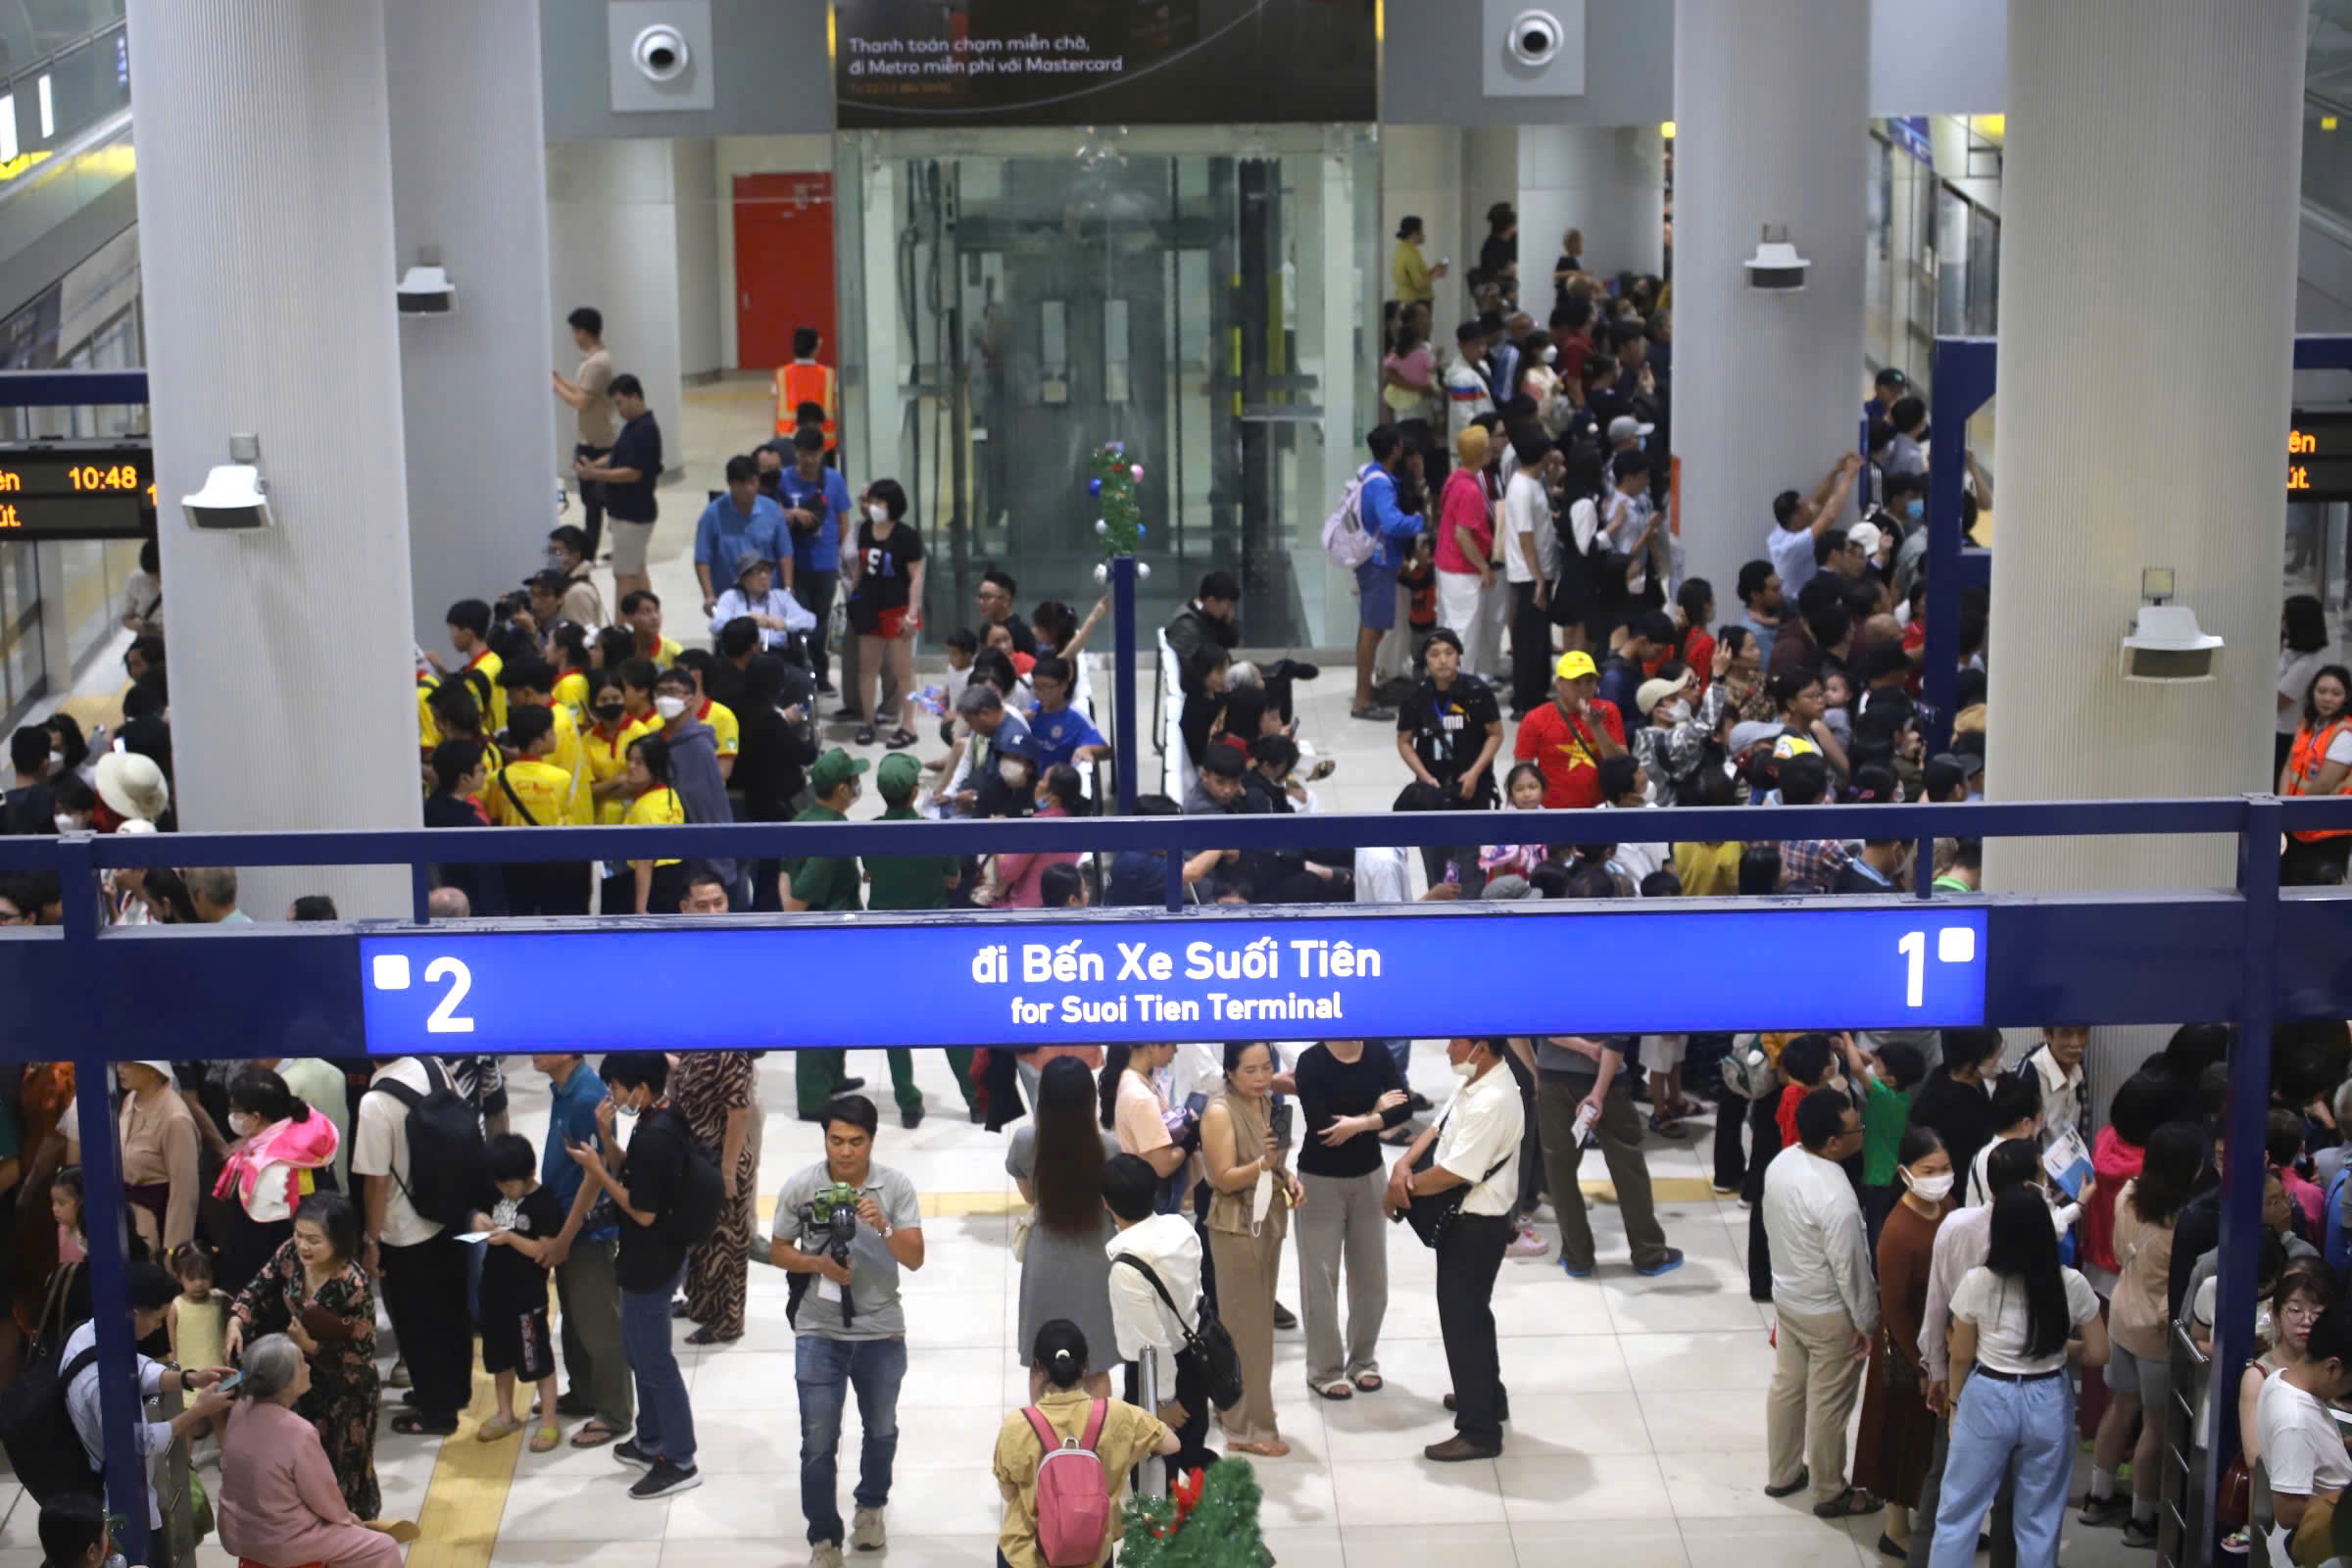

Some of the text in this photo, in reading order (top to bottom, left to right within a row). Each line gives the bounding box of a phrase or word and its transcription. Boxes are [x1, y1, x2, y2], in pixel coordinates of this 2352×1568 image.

[847, 36, 905, 54] Thanh
[907, 37, 951, 53] toán
[954, 36, 1003, 54] chạm
[848, 59, 865, 75] đi
[868, 59, 920, 74] Metro
[968, 59, 995, 76] phí
[1025, 56, 1124, 74] Mastercard
[69, 465, 138, 490] 10:48
[971, 936, 1381, 984] đi Bến Xe Suối Tiên
[1898, 931, 1926, 1007] 1
[424, 956, 475, 1034] 2
[1010, 991, 1344, 1024] for Suoi Tien Terminal
